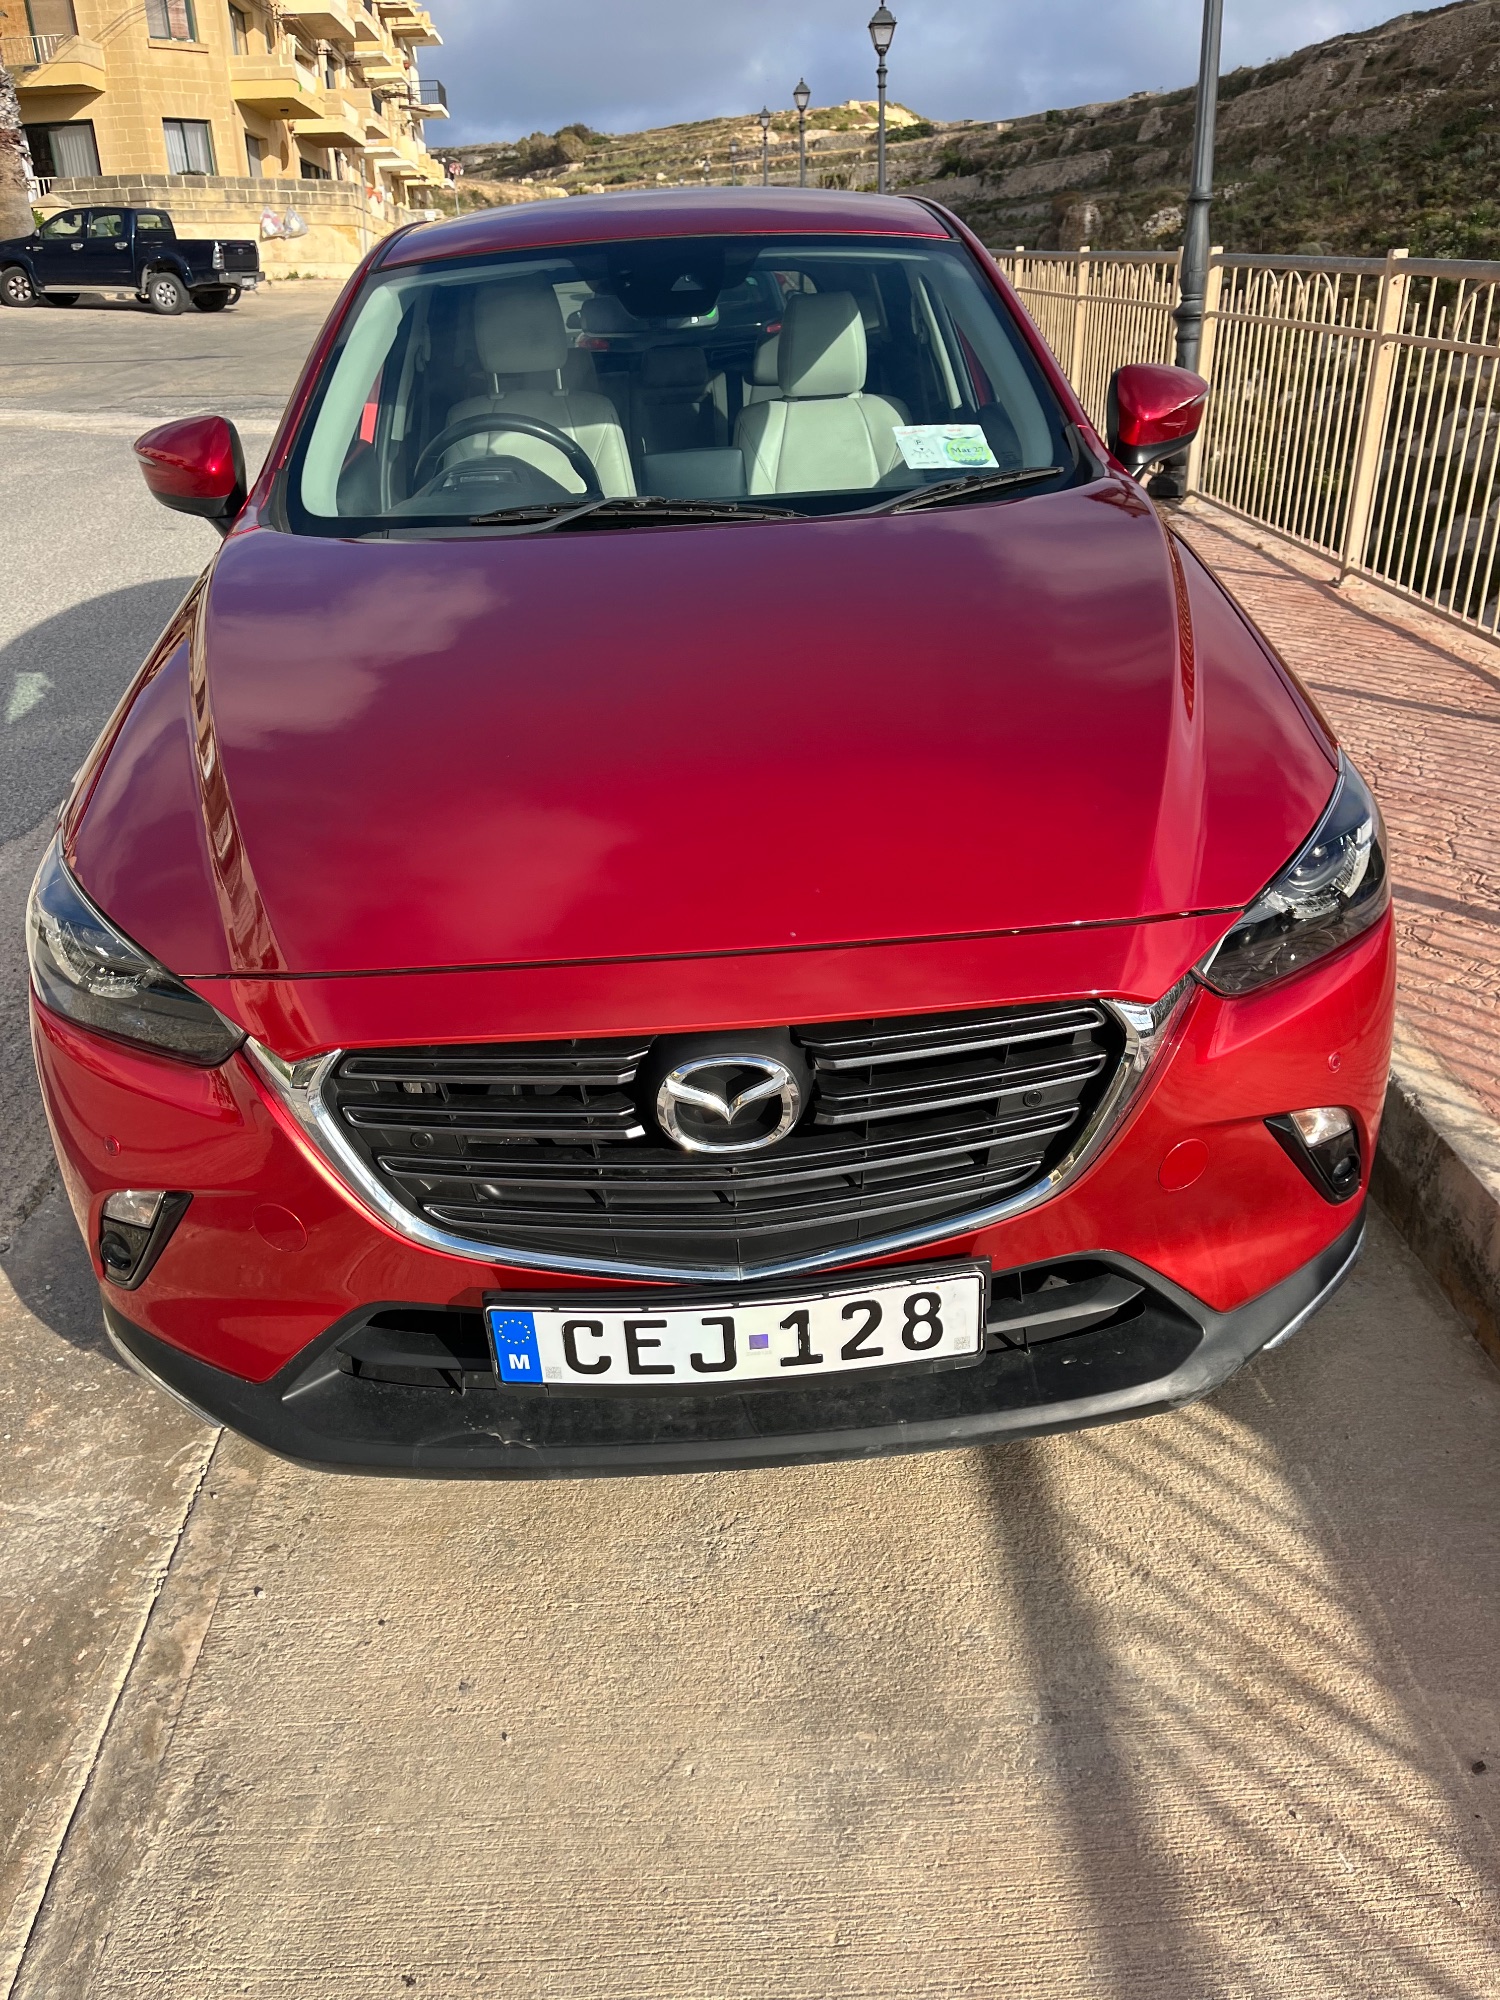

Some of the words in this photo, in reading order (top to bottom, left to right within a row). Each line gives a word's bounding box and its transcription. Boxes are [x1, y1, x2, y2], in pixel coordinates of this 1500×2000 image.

[561, 1316, 737, 1376] CEJ
[779, 1291, 944, 1367] 128
[508, 1353, 531, 1370] M
